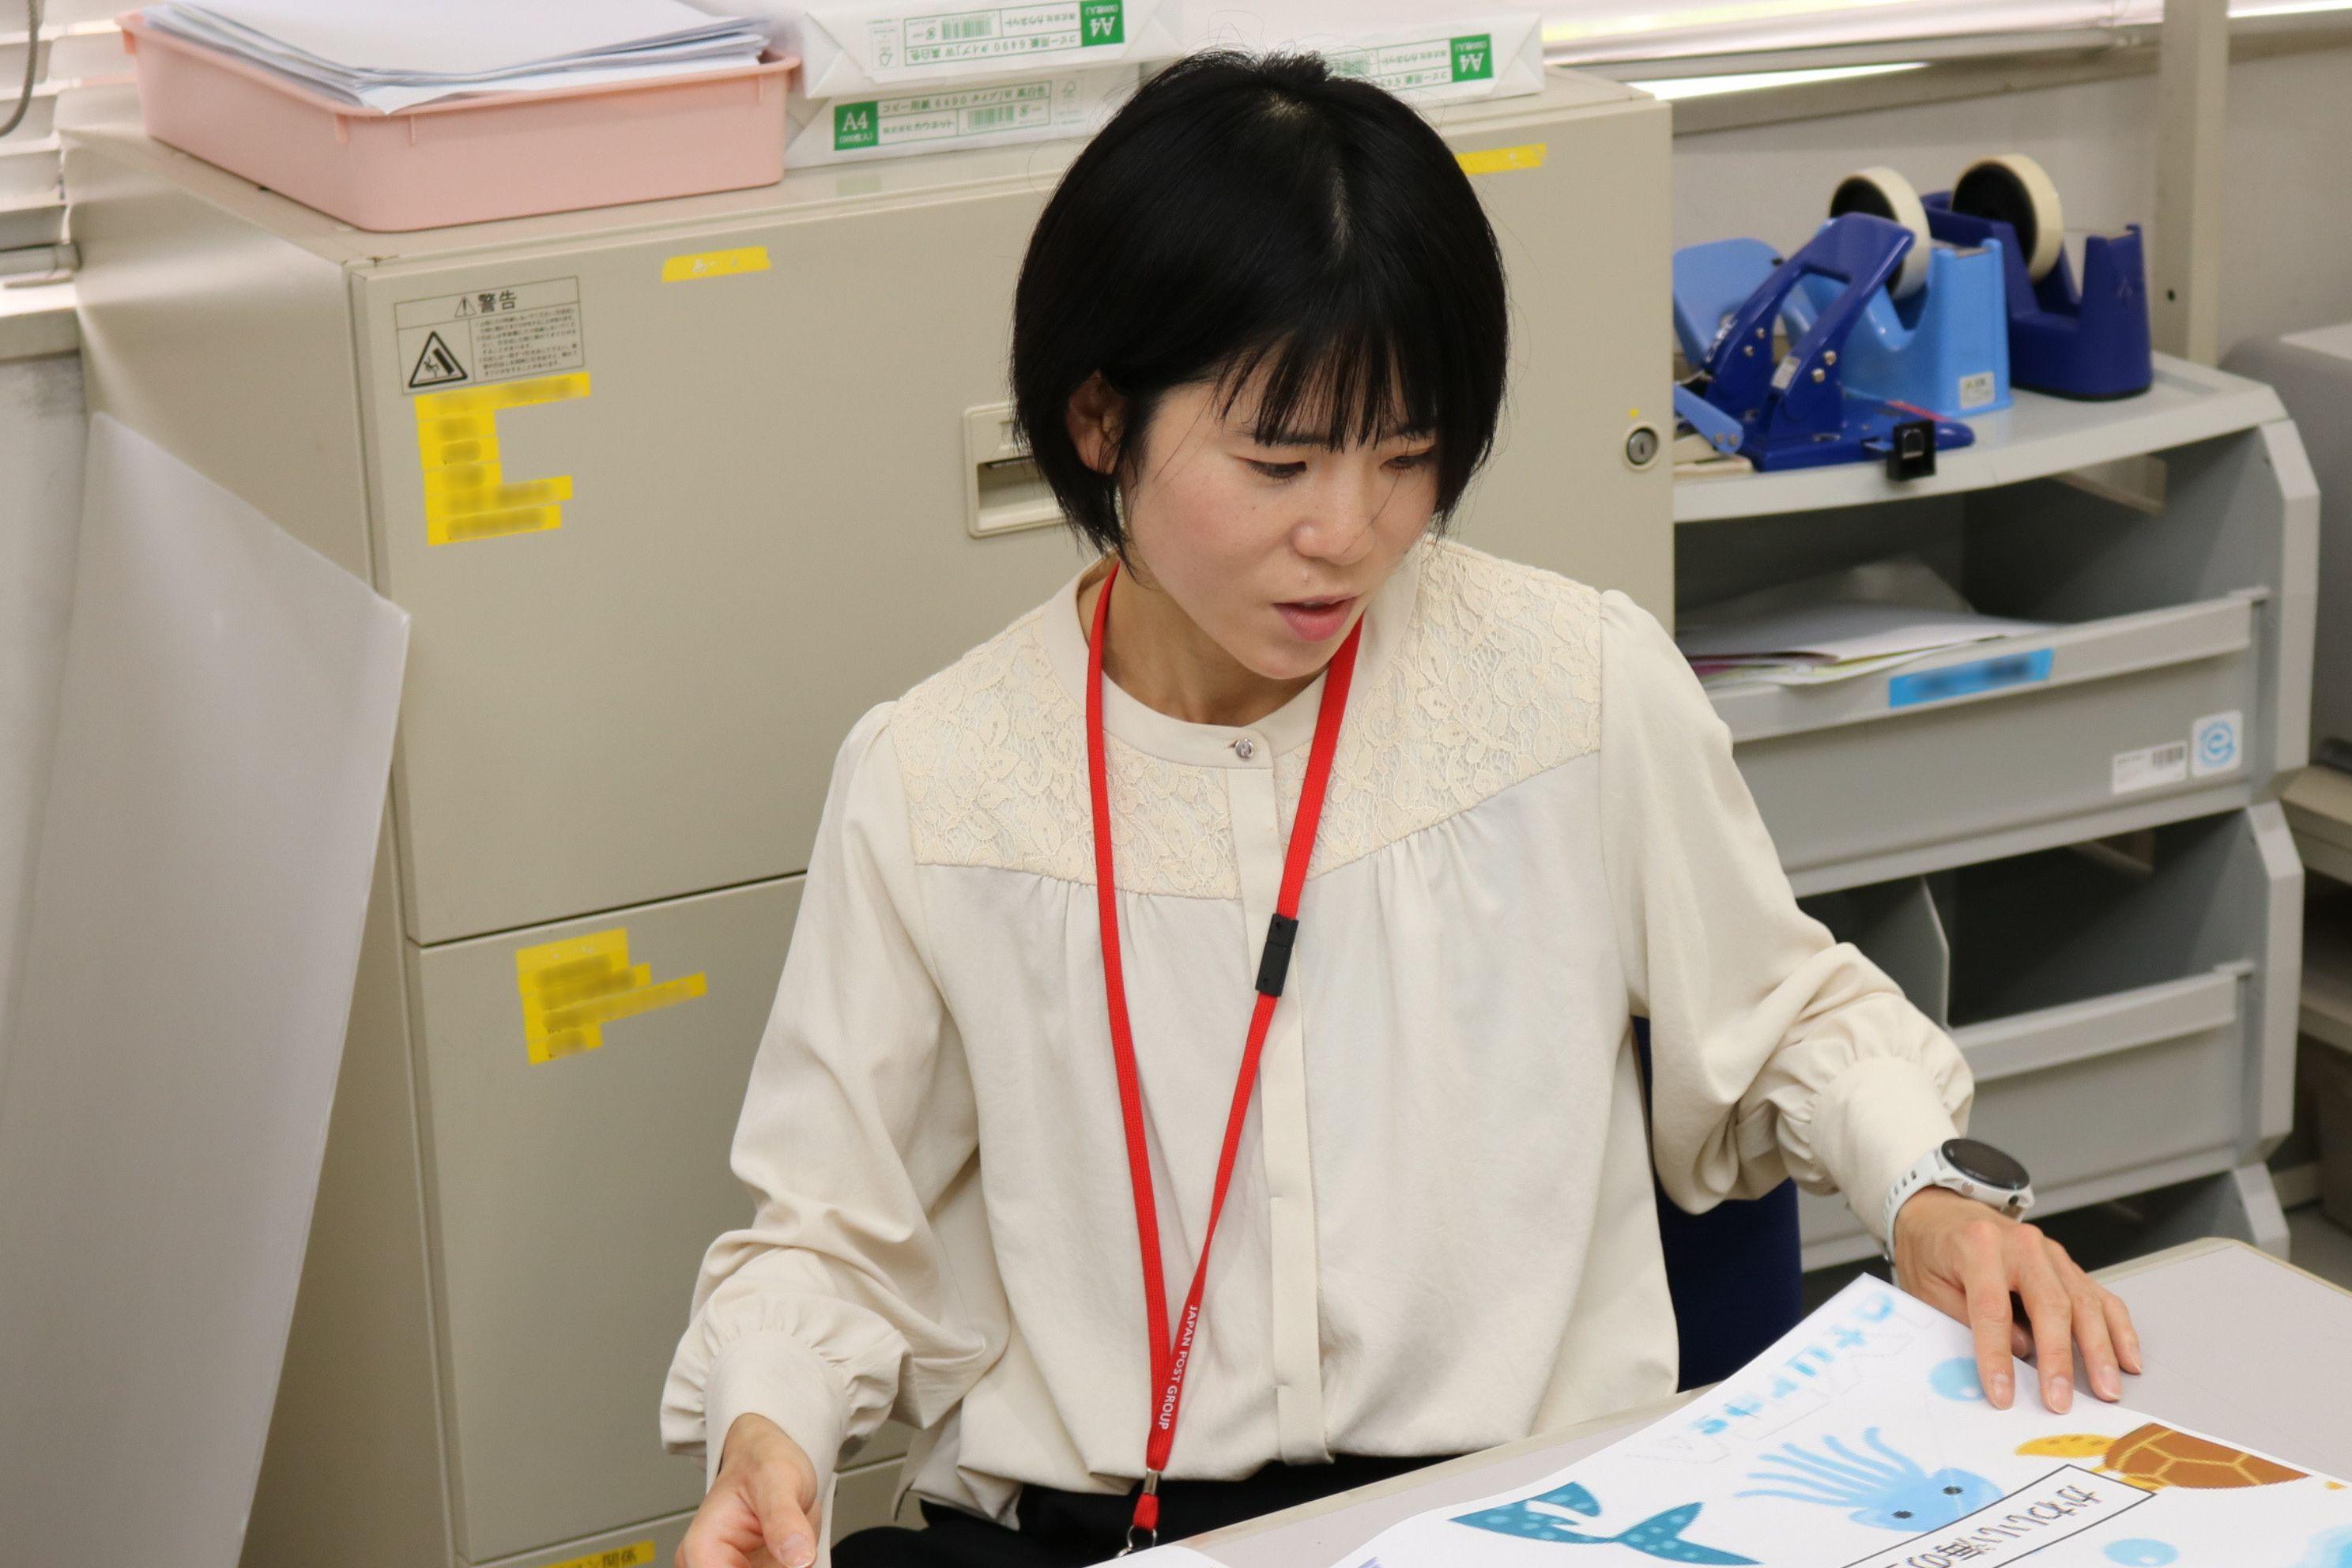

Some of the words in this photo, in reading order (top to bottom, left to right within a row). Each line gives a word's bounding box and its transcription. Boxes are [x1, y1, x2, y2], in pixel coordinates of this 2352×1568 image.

[1091, 16, 1115, 37] A4
[1459, 52, 1484, 74] A4
[842, 111, 869, 132] A4
[477, 290, 517, 314] 警告
[1180, 1306, 1198, 1347] JAPAN
[1170, 1351, 1189, 1384] POST
[1158, 1385, 1178, 1430] GROUP
[1883, 1485, 2102, 1568] かわいい海の
